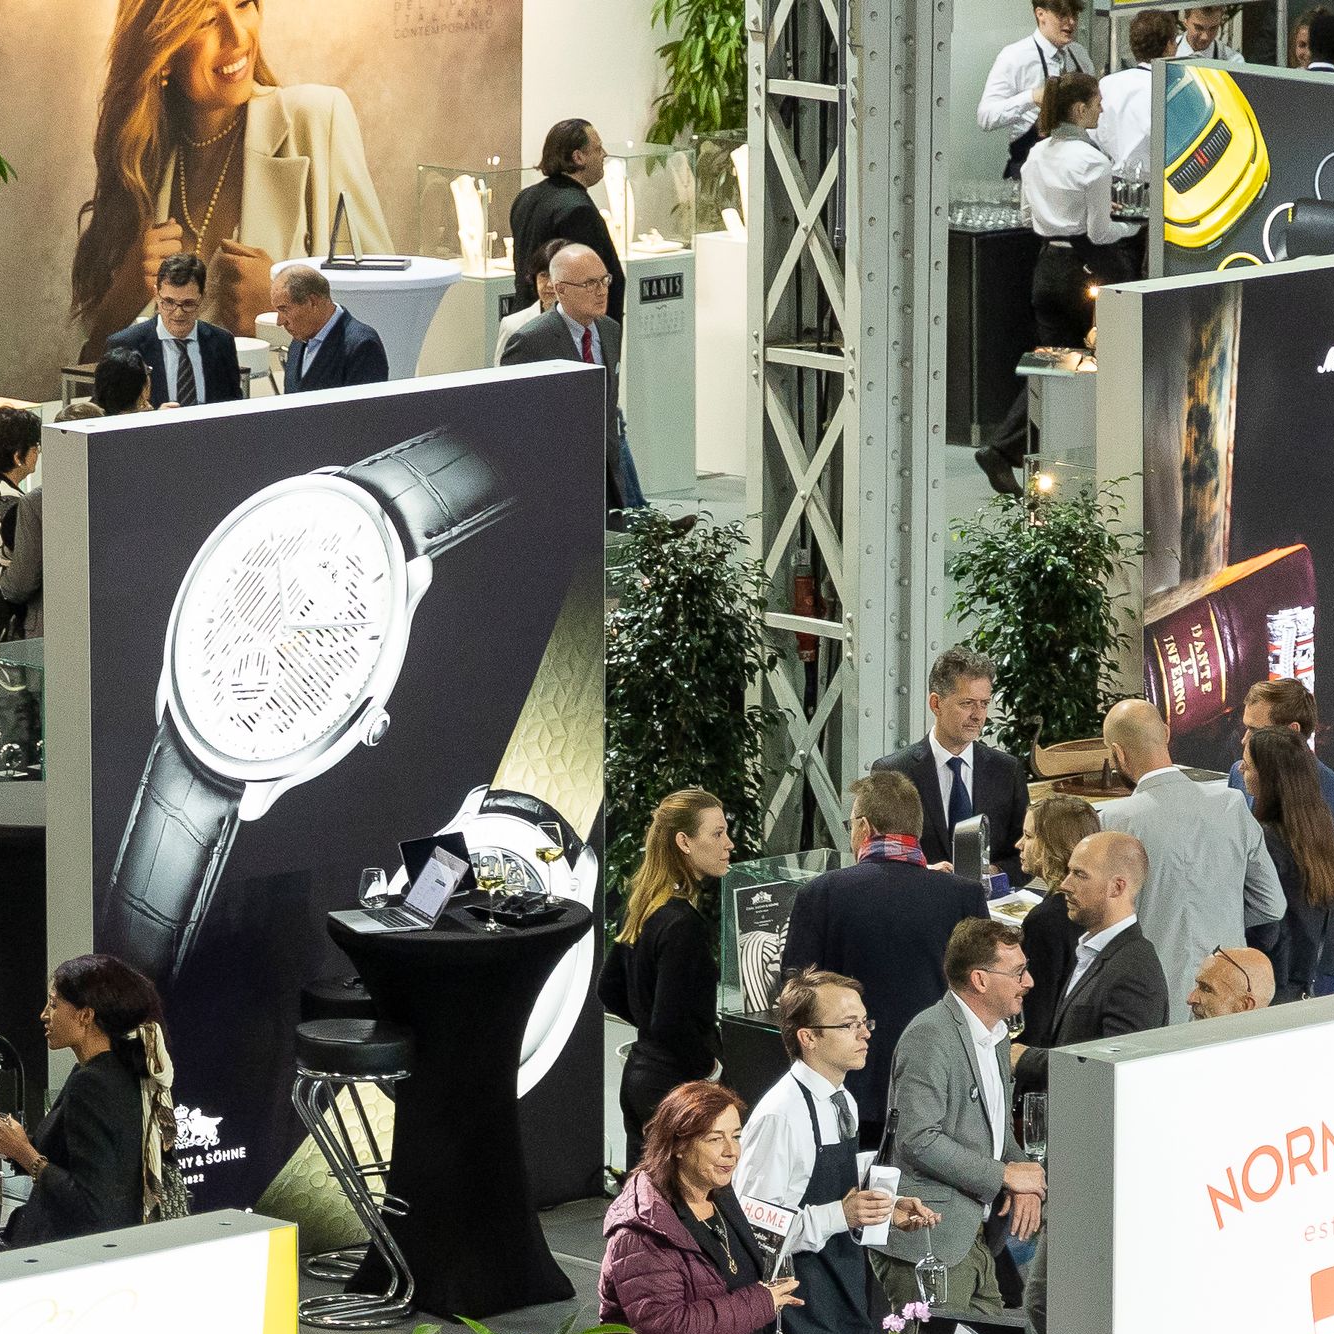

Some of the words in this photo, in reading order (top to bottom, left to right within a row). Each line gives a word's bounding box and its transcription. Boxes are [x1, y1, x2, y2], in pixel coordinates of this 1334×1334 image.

[641, 275, 682, 297] NANIS
[1163, 634, 1187, 716] INFERNO
[1190, 623, 1214, 695] DANTE
[194, 1154, 205, 1167] &
[205, 1146, 247, 1165] SÖHNE
